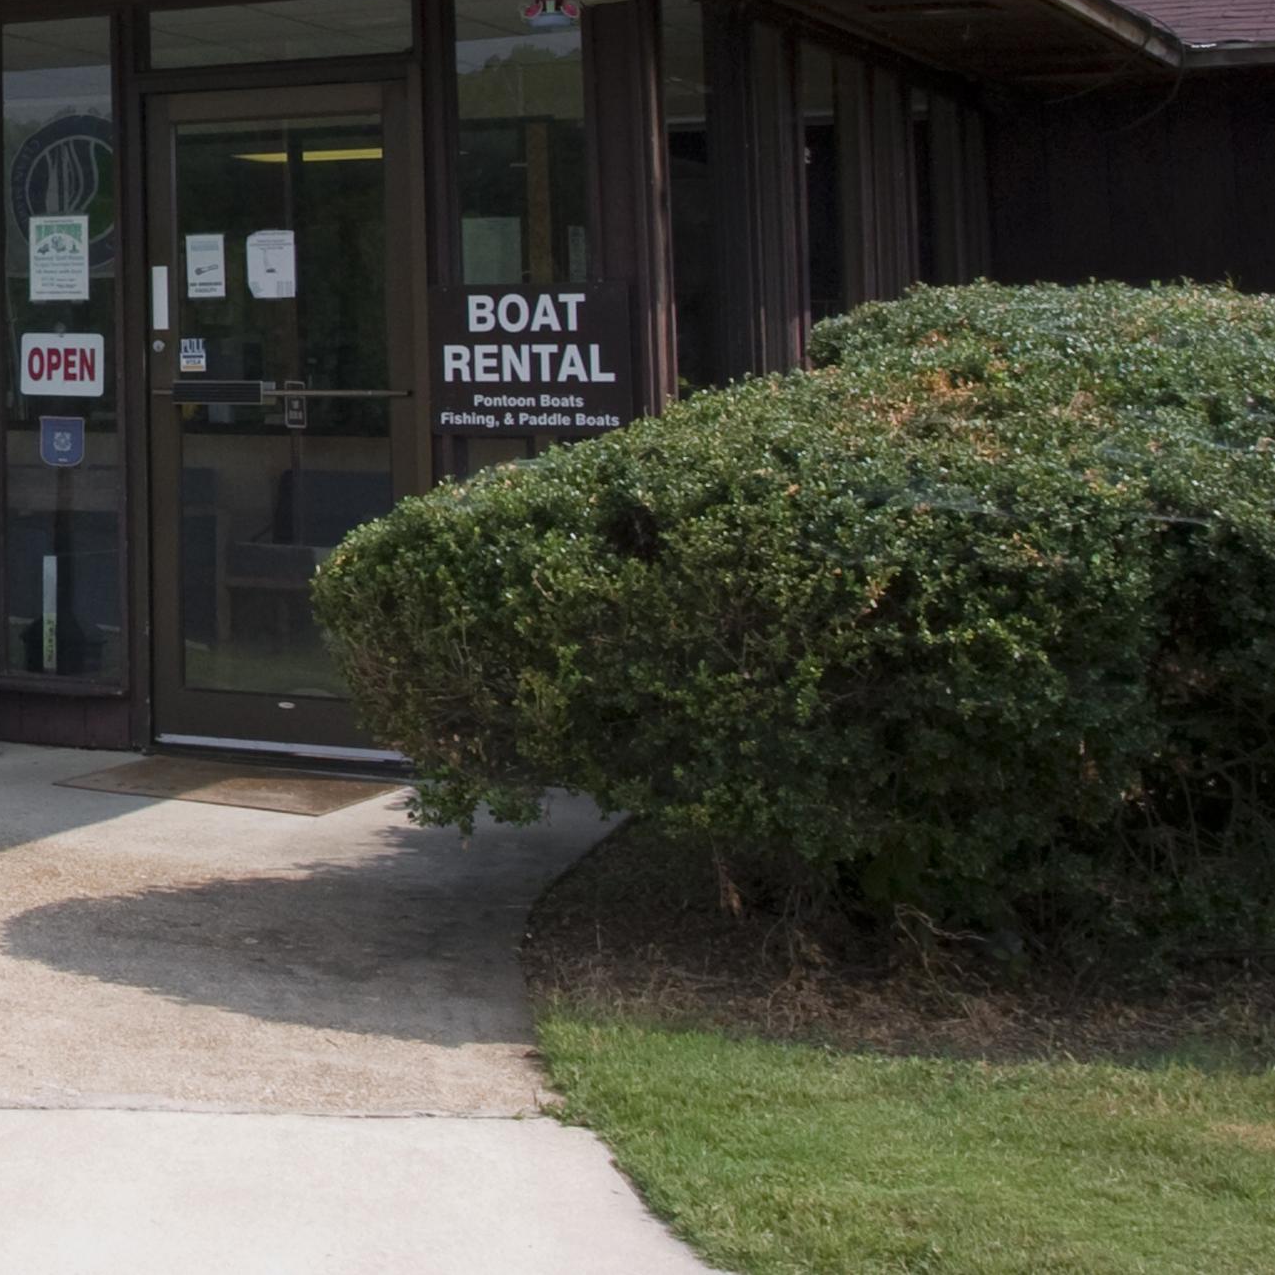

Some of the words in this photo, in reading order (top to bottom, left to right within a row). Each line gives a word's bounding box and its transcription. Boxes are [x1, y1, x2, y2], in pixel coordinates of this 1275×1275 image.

[467, 293, 586, 333] BOAT
[27, 347, 96, 382] OPEN
[443, 343, 616, 383] RENTAL
[473, 394, 536, 408] Pontoon
[540, 394, 584, 408] Boats
[440, 411, 500, 428] Fishing,
[503, 413, 515, 426] &
[519, 412, 571, 426] Paddle
[575, 413, 620, 427] Boats
